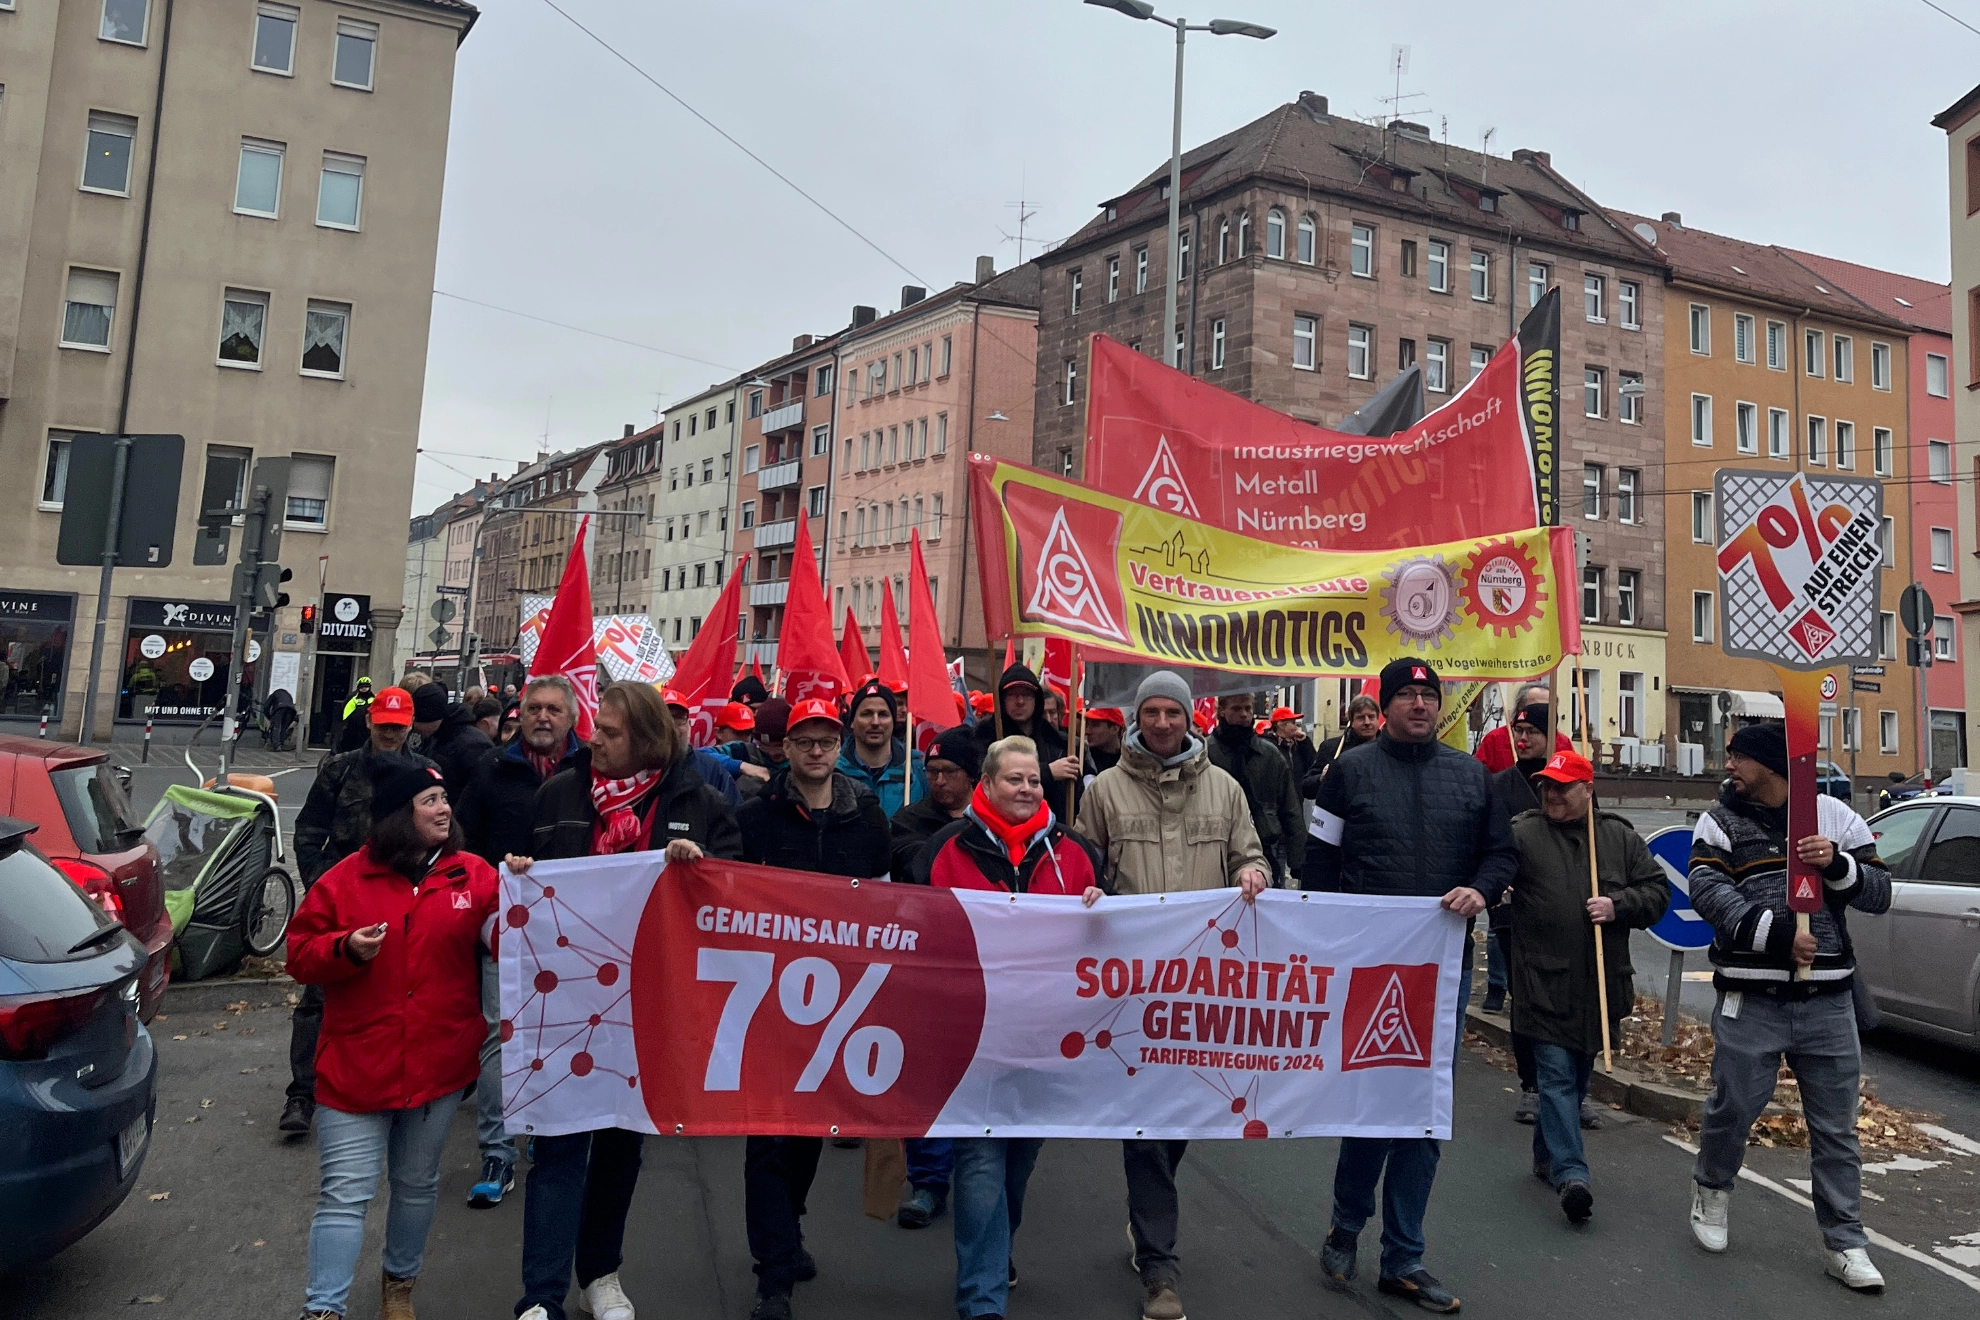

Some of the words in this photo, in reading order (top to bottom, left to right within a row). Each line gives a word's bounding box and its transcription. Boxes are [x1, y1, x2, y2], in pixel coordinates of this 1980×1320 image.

[1234, 397, 1502, 464] Industriegewerkschaft
[1235, 469, 1318, 496] Metall
[1236, 505, 1367, 532] Nürnberg
[1717, 478, 1853, 614] 7%
[1802, 561, 1834, 602] AUF
[1827, 512, 1875, 564] EINEN
[1128, 560, 1369, 603] Vertrauensleute
[1817, 541, 1879, 617] STREICH
[321, 622, 367, 638] DIVINE
[645, 635, 661, 664] STREICH
[1135, 602, 1369, 668] INNOMOTICS
[1445, 654, 1552, 671] Vogelweiherstraße
[1822, 680, 1834, 693] 30
[144, 706, 159, 714] MIT
[161, 706, 178, 715] UND
[180, 706, 201, 715] OHNE
[696, 905, 860, 947] GEMEINSAM
[866, 923, 920, 952] FÜR
[1075, 953, 1335, 1005] SOLIDARITÄT
[696, 947, 905, 1096] 7%
[1142, 1000, 1331, 1048] GEWINNT
[1139, 1046, 1279, 1072] TARIFBEWEGUNG
[1283, 1053, 1325, 1072] 2024
